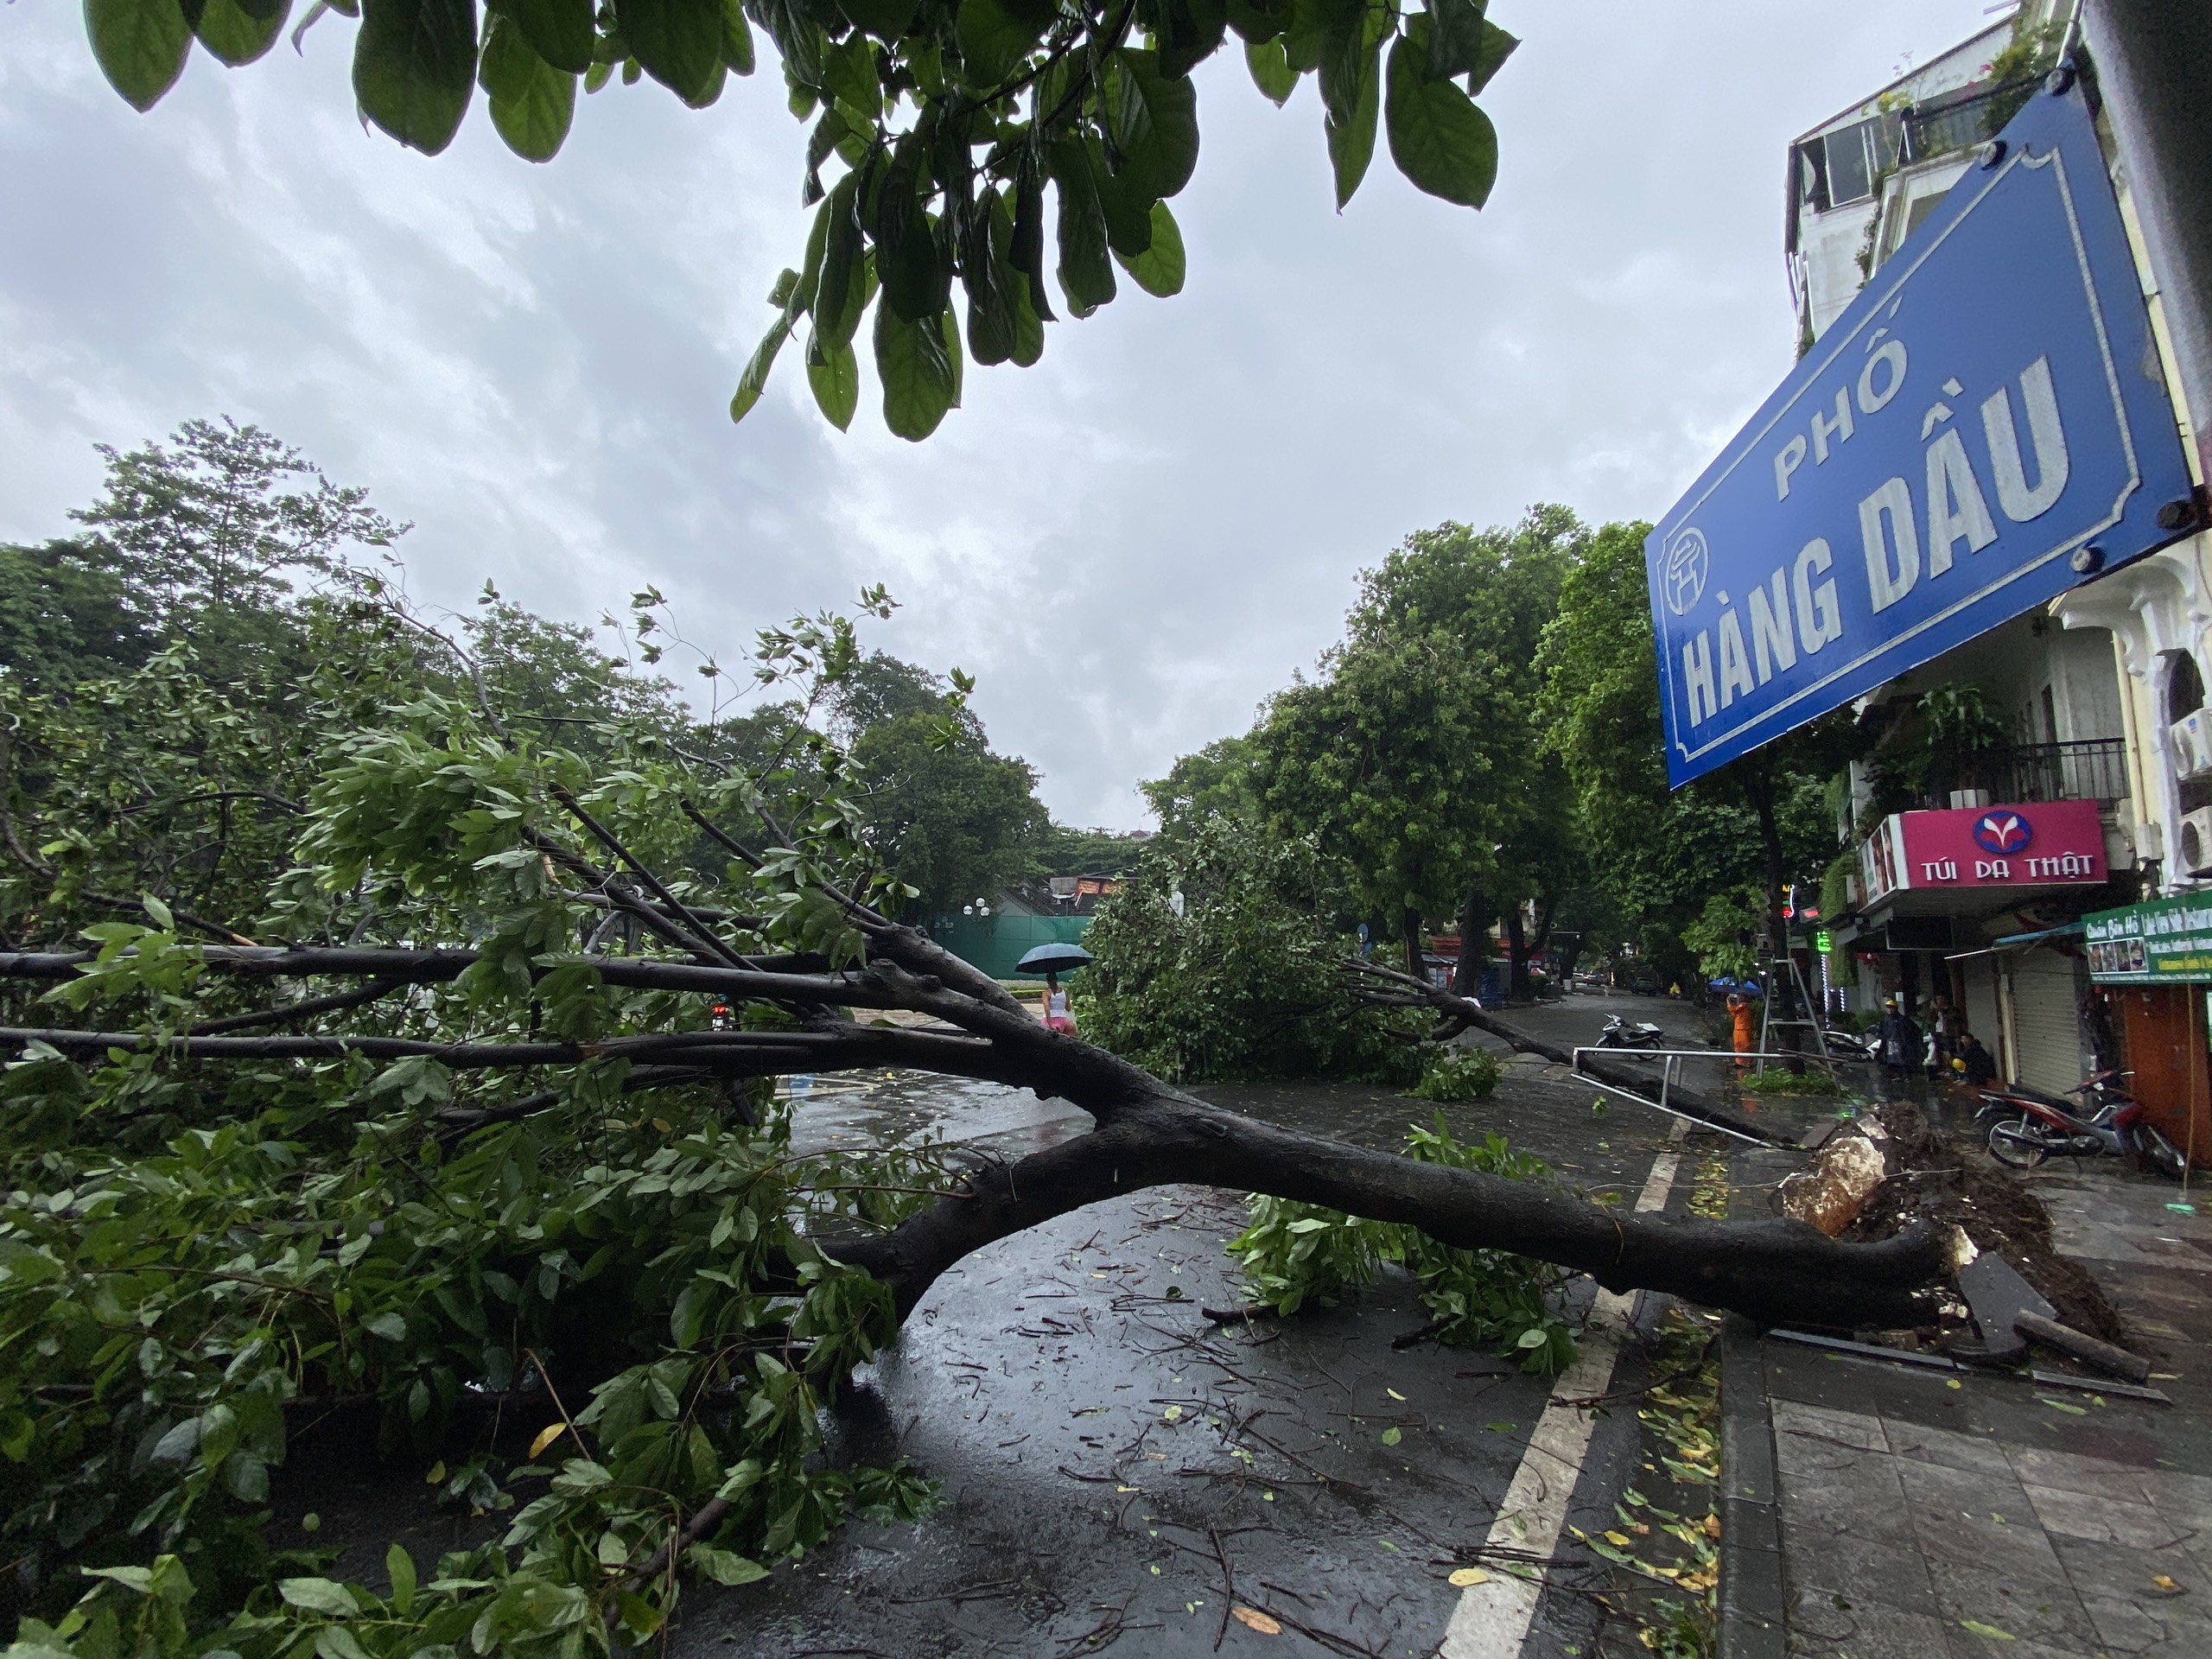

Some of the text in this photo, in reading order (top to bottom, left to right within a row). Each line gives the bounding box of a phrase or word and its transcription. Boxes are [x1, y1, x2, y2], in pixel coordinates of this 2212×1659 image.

[1774, 295, 1908, 503] PHỐ
[1683, 354, 2069, 728] HÀNG DẦU
[1921, 850, 2094, 881] TÚI DA THẬT
